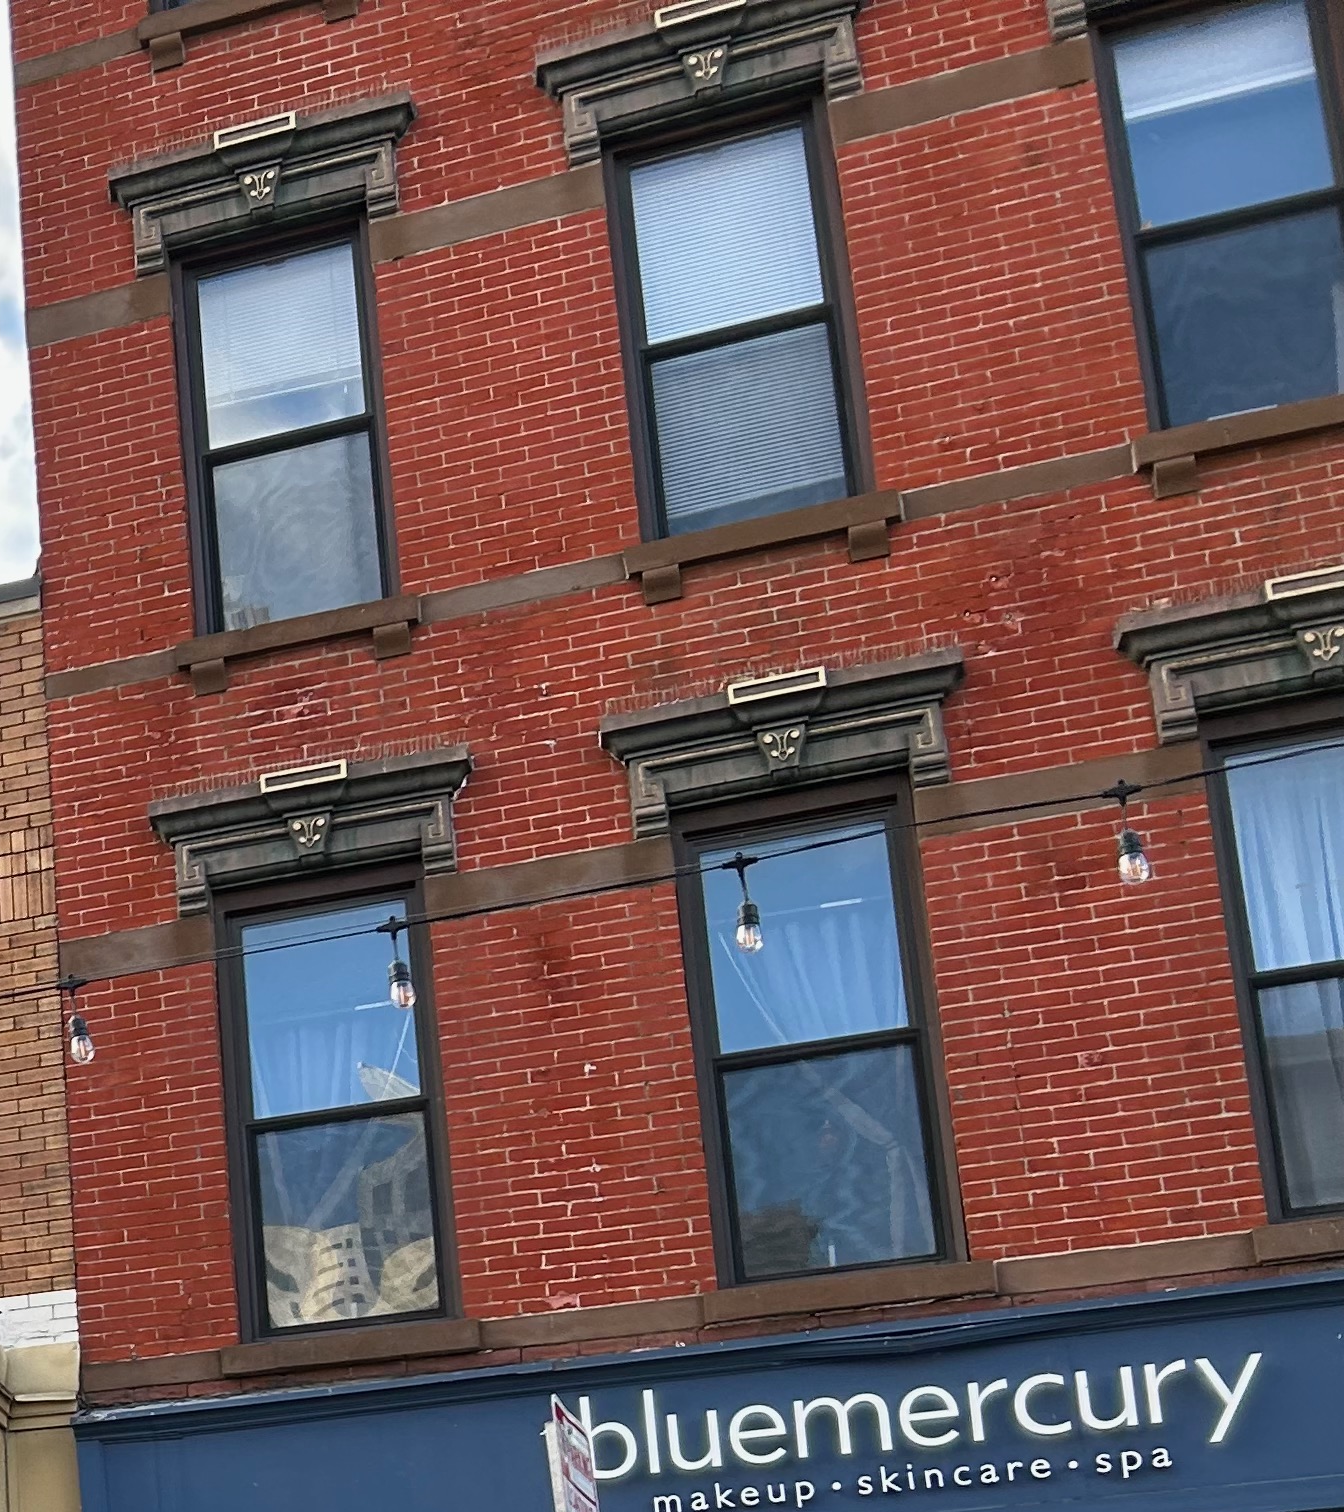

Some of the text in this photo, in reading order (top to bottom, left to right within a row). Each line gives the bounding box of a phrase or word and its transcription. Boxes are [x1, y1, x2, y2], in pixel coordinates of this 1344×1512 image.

[578, 1352, 1263, 1479] bluemercury
[857, 1458, 1052, 1496] skincare
[1096, 1444, 1174, 1477] spa
